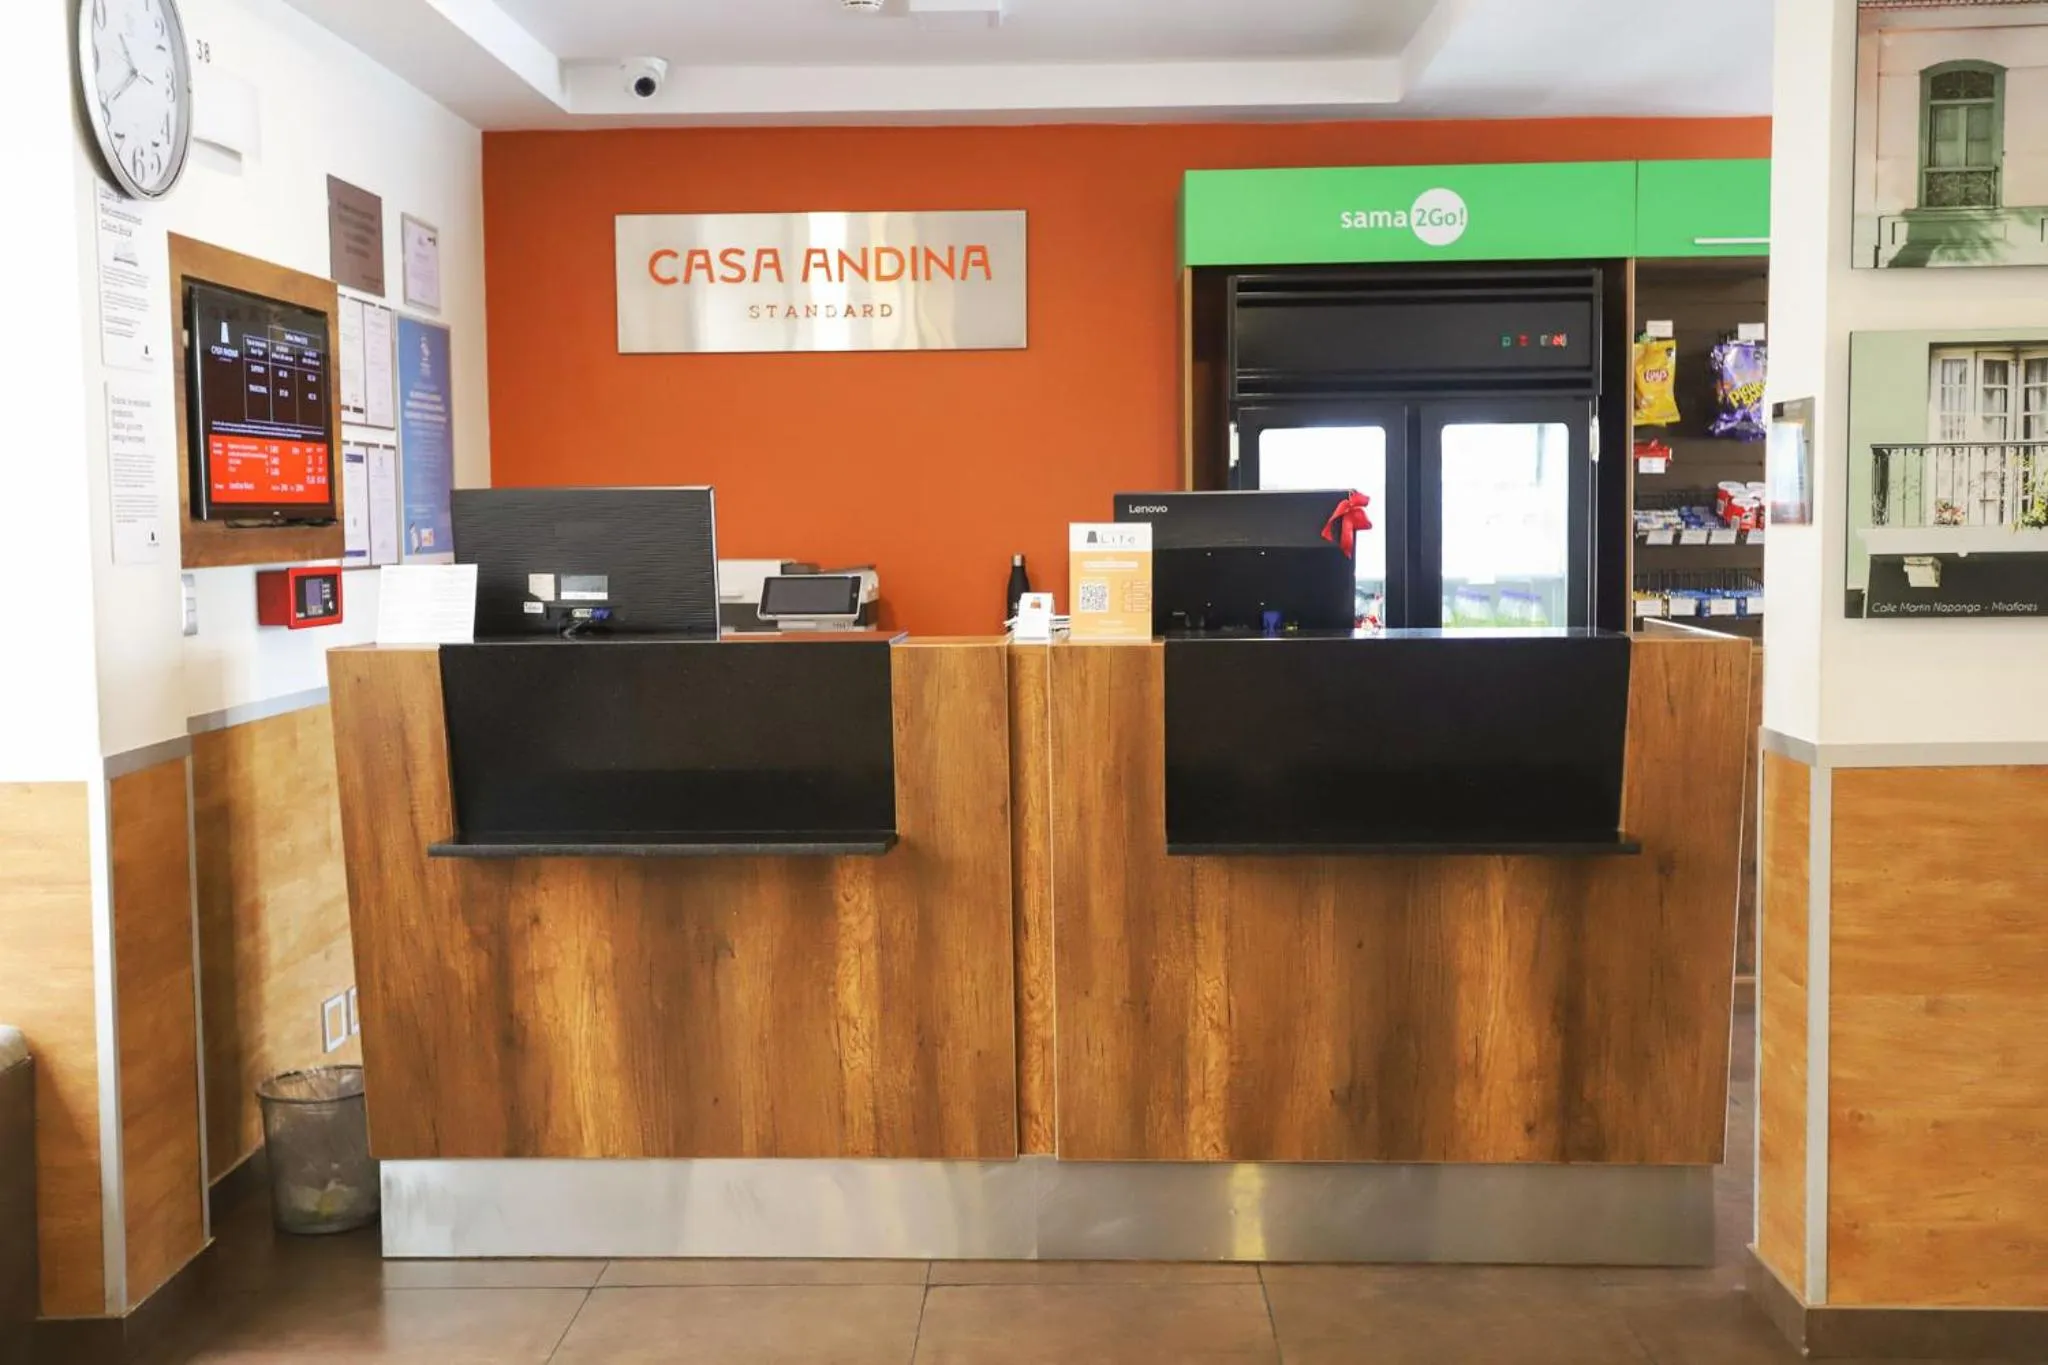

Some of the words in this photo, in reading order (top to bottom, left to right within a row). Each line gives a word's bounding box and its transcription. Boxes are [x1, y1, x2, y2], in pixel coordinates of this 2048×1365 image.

[131, 146, 146, 185] 6
[1340, 208, 1408, 229] sama
[1415, 207, 1465, 228] 2Go!
[648, 247, 784, 286] CASA
[801, 245, 993, 283] ANDINA
[749, 303, 894, 320] STANDARD
[1128, 504, 1168, 514] Lenovo
